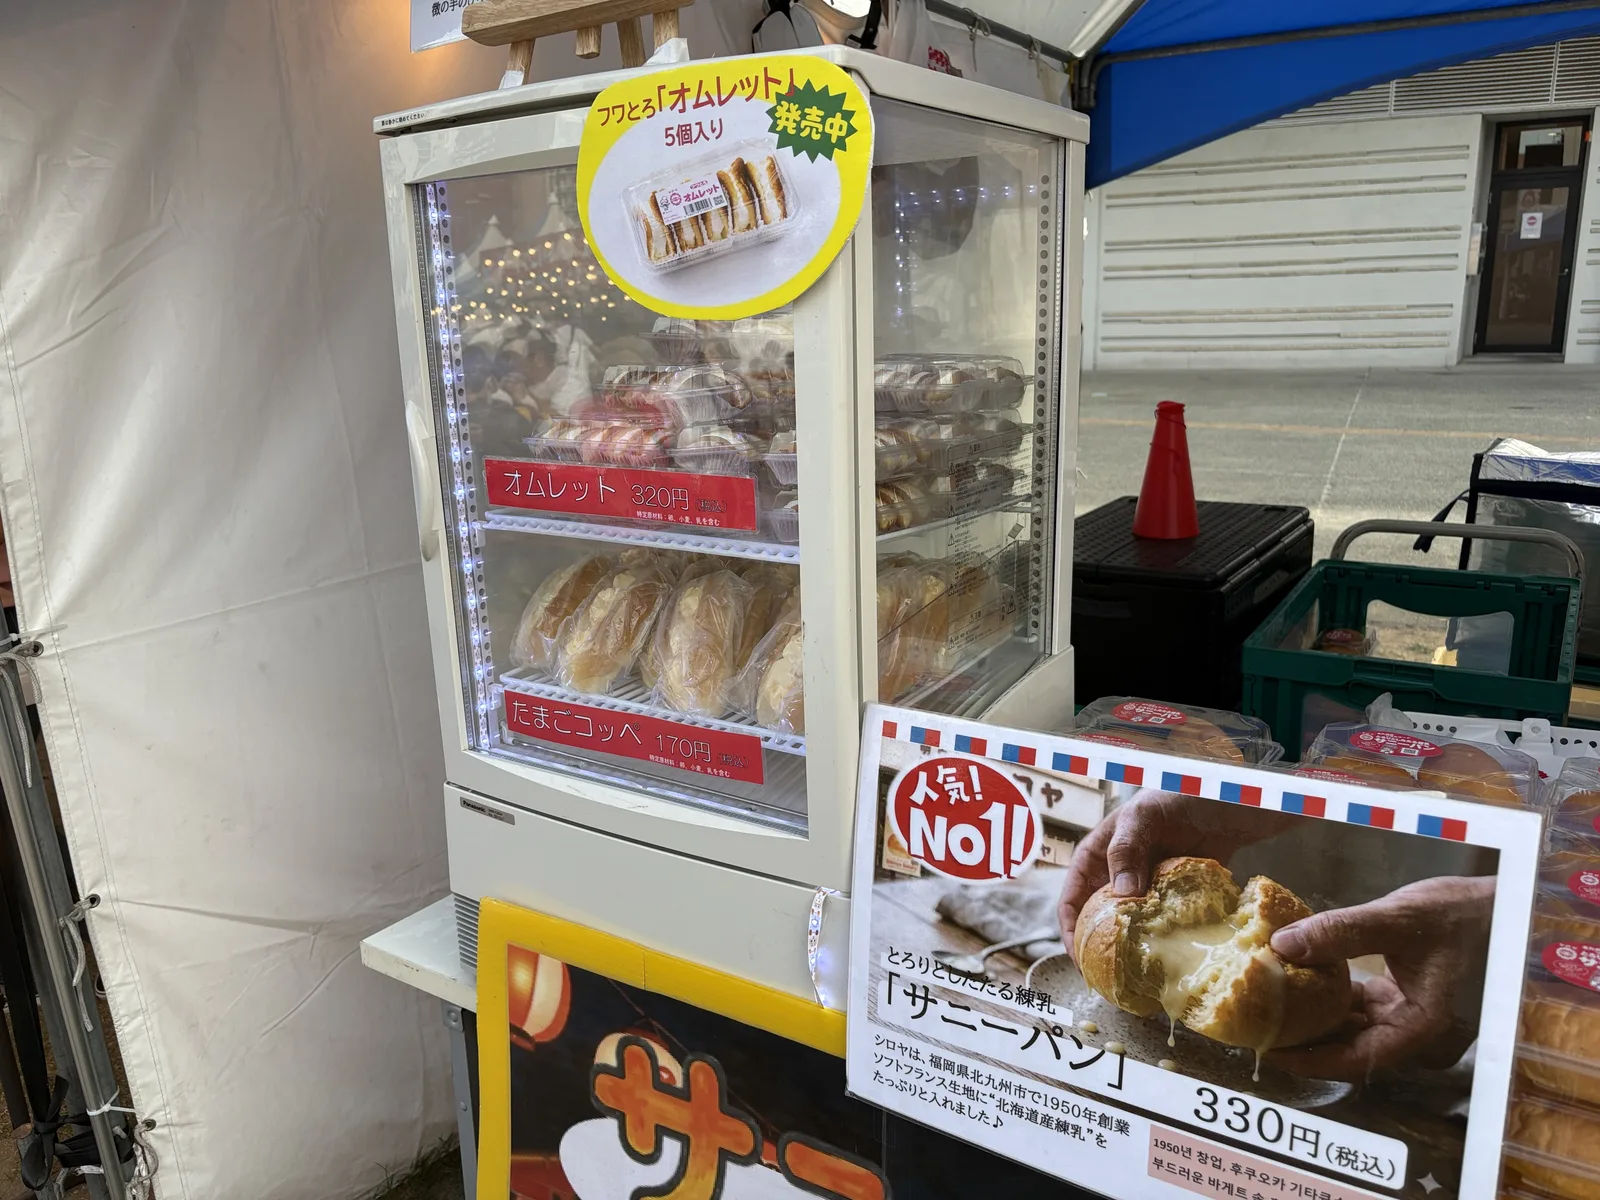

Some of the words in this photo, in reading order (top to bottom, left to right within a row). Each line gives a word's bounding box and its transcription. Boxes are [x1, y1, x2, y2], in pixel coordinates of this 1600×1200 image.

[664, 118, 723, 147] 5個入り
[775, 100, 848, 144] 発売中
[683, 184, 720, 202] オムレット
[503, 470, 616, 503] オムレット
[631, 484, 689, 511] 320円
[512, 700, 642, 744] たまごコッペ
[656, 732, 711, 763] 170円
[1375, 737, 1436, 751] サニーパン
[909, 765, 984, 806] 人気!
[887, 946, 1056, 1016] とろりとしたたる練乳
[887, 971, 1125, 1091] 「サニーパン」
[874, 1034, 1131, 1137] シロヤは、福岡県北九州市で1950年創業
[1152, 1157, 1204, 1185] 부드러운
[1208, 1176, 1248, 1200] 바게트
[1153, 1138, 1192, 1160] 1950년
[1197, 1150, 1226, 1172] 창업,
[1230, 1162, 1285, 1191] 후쿠오카
